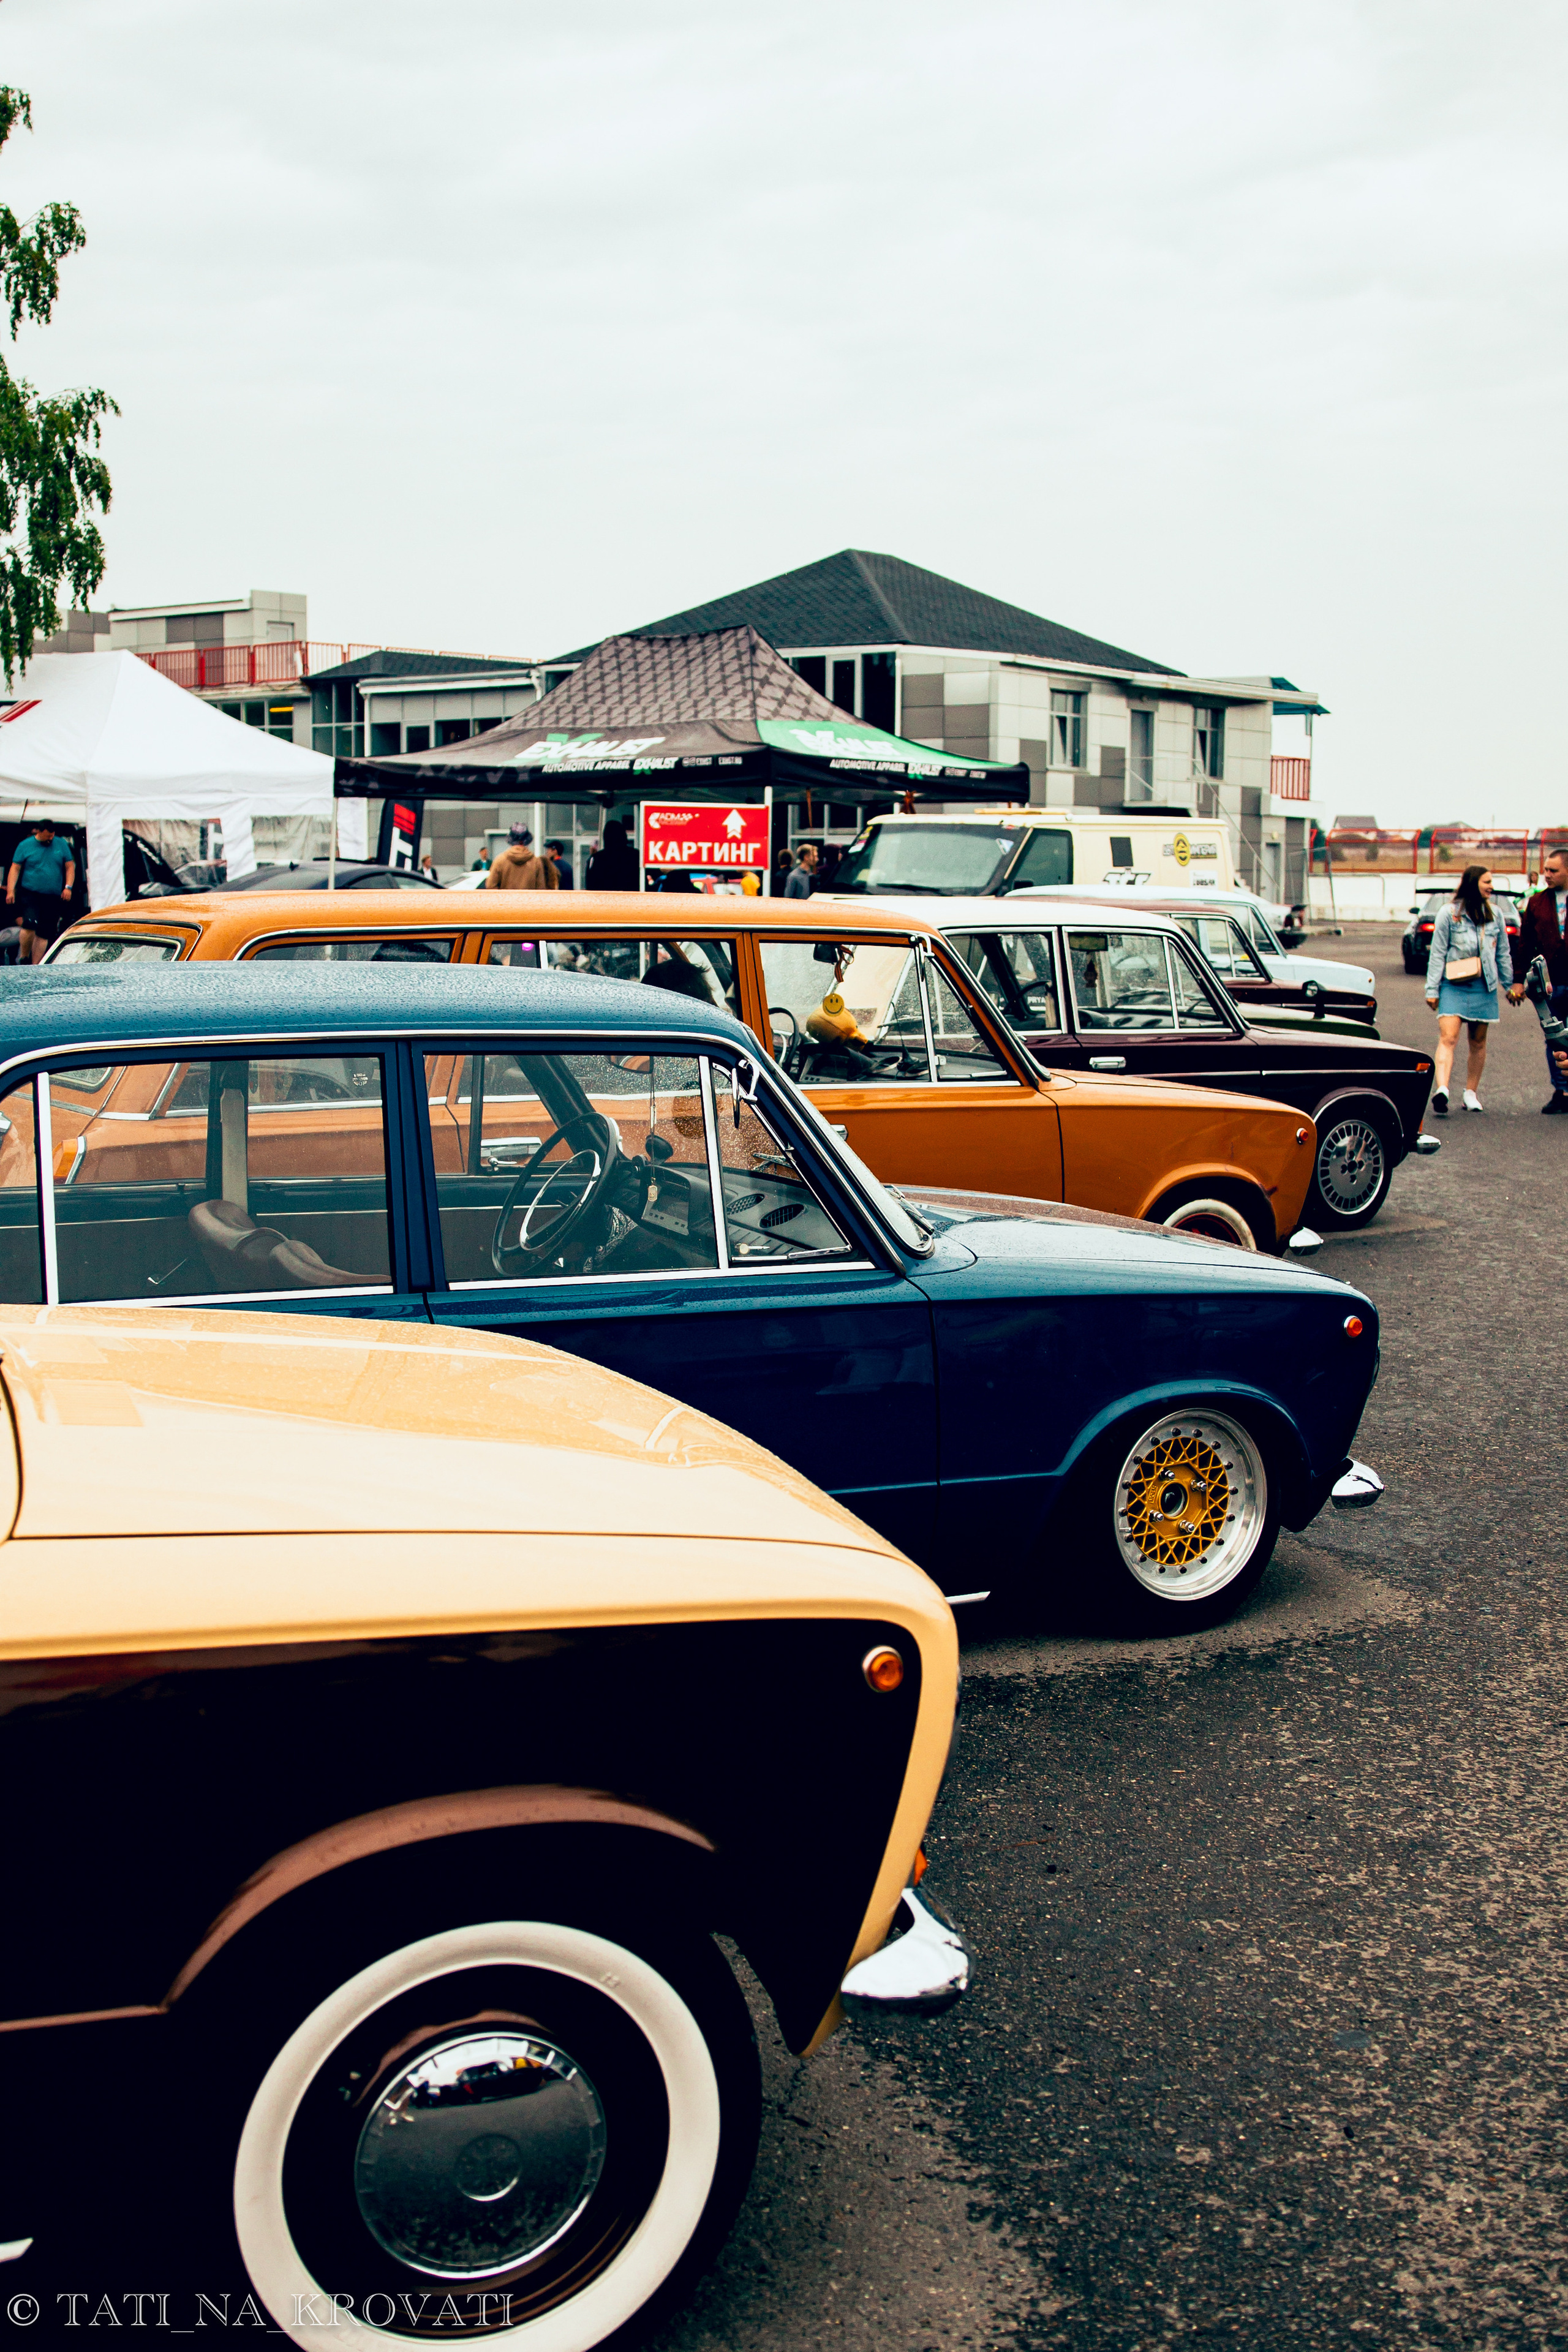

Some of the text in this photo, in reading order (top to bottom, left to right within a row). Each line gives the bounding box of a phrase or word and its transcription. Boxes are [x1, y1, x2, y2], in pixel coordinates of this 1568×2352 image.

[513, 734, 666, 761] EXHAUST
[541, 761, 594, 774] AUTOMOTIVE
[594, 760, 631, 770] APPAREL
[633, 757, 679, 772] EXHAUST
[829, 759, 876, 771] AUTOMOTIVE
[876, 761, 906, 773] APPAREL
[648, 840, 761, 863] КАРТИНГ
